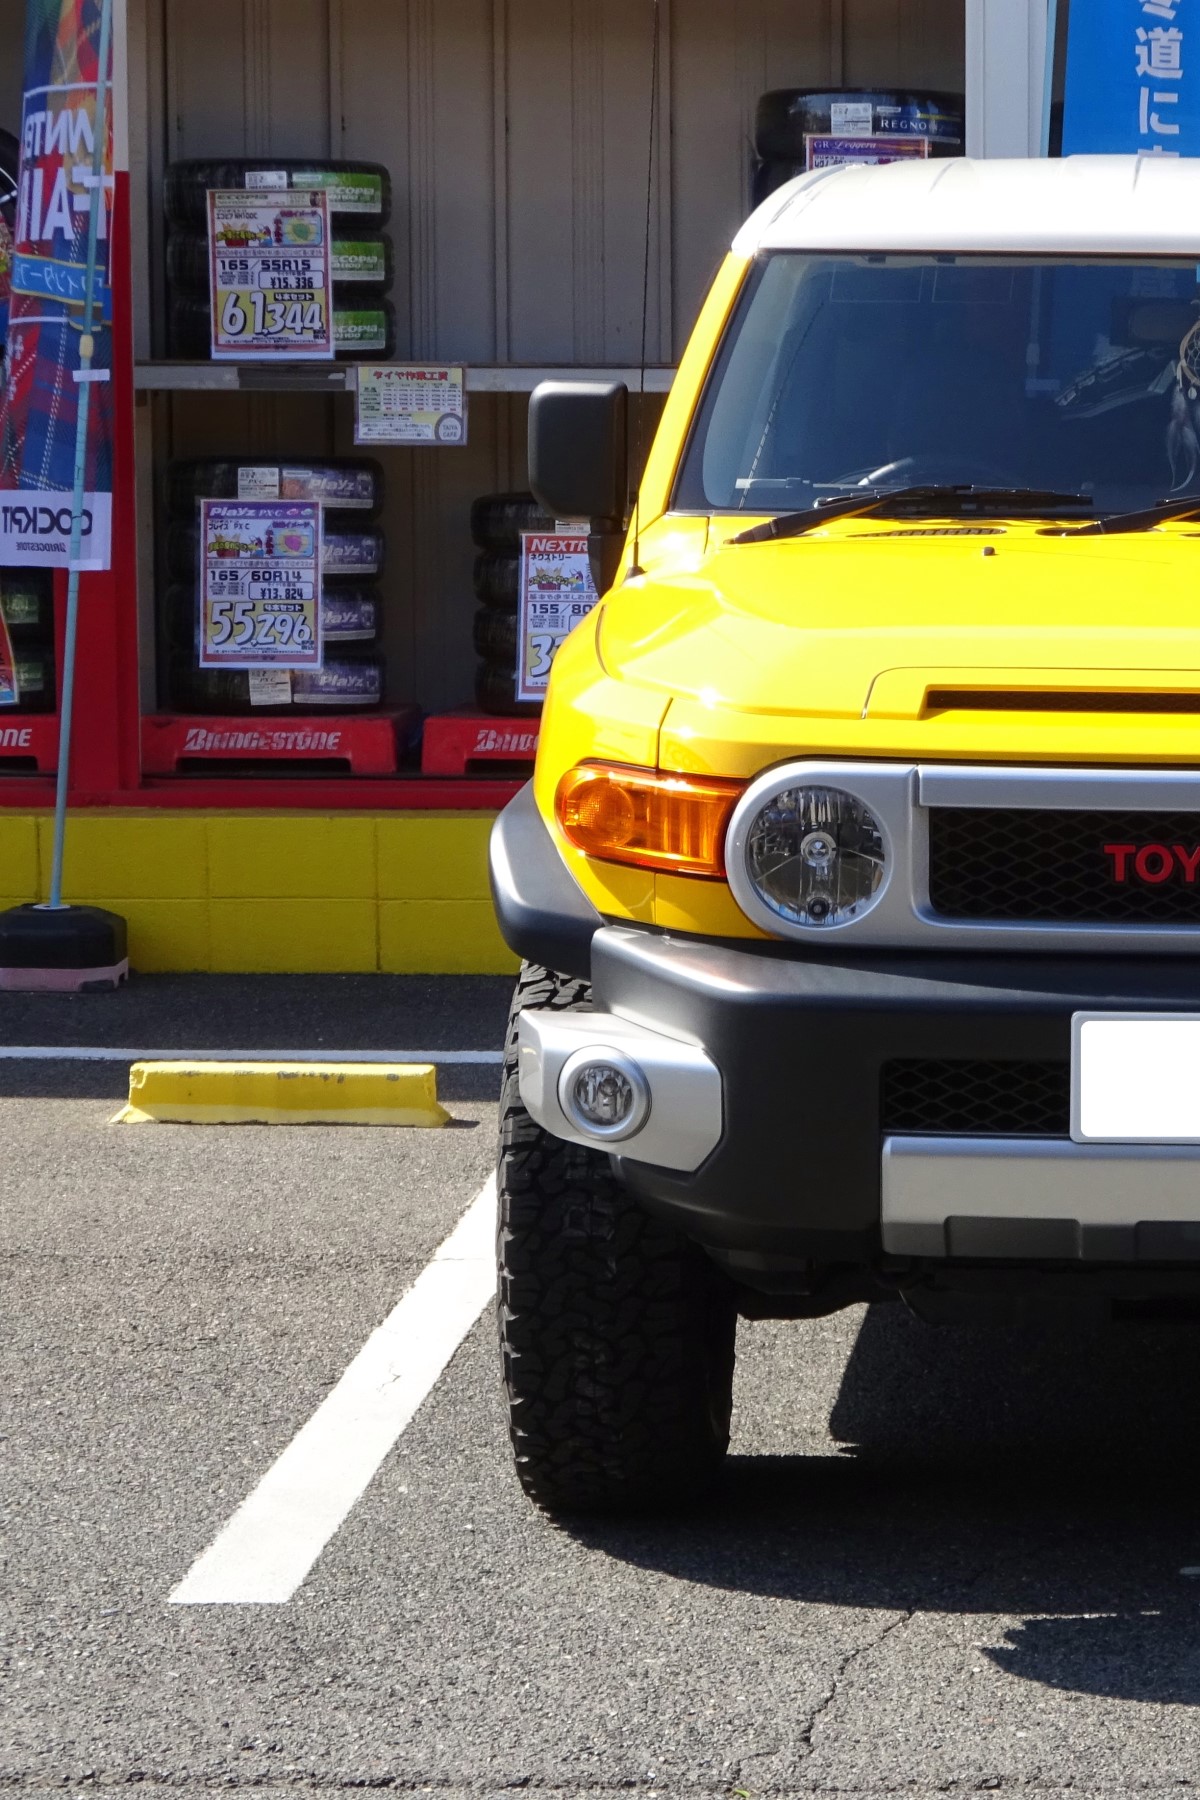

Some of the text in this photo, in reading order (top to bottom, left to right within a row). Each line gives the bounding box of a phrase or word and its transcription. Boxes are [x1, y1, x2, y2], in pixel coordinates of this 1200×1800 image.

[1135, 0, 1184, 158] 道に
[881, 119, 927, 131] REGNO
[220, 260, 311, 271] 165/55R15
[222, 291, 323, 336] 61,344
[308, 479, 355, 491] Playz
[209, 507, 256, 516] Playz
[530, 538, 588, 552] NEXTR
[530, 553, 572, 561] ネクストリー
[210, 570, 302, 581] 165/60R14
[531, 603, 594, 614] 155/80
[211, 602, 313, 647] 55,296
[320, 674, 364, 687] Playz
[183, 728, 341, 751] BRIDGESTONE
